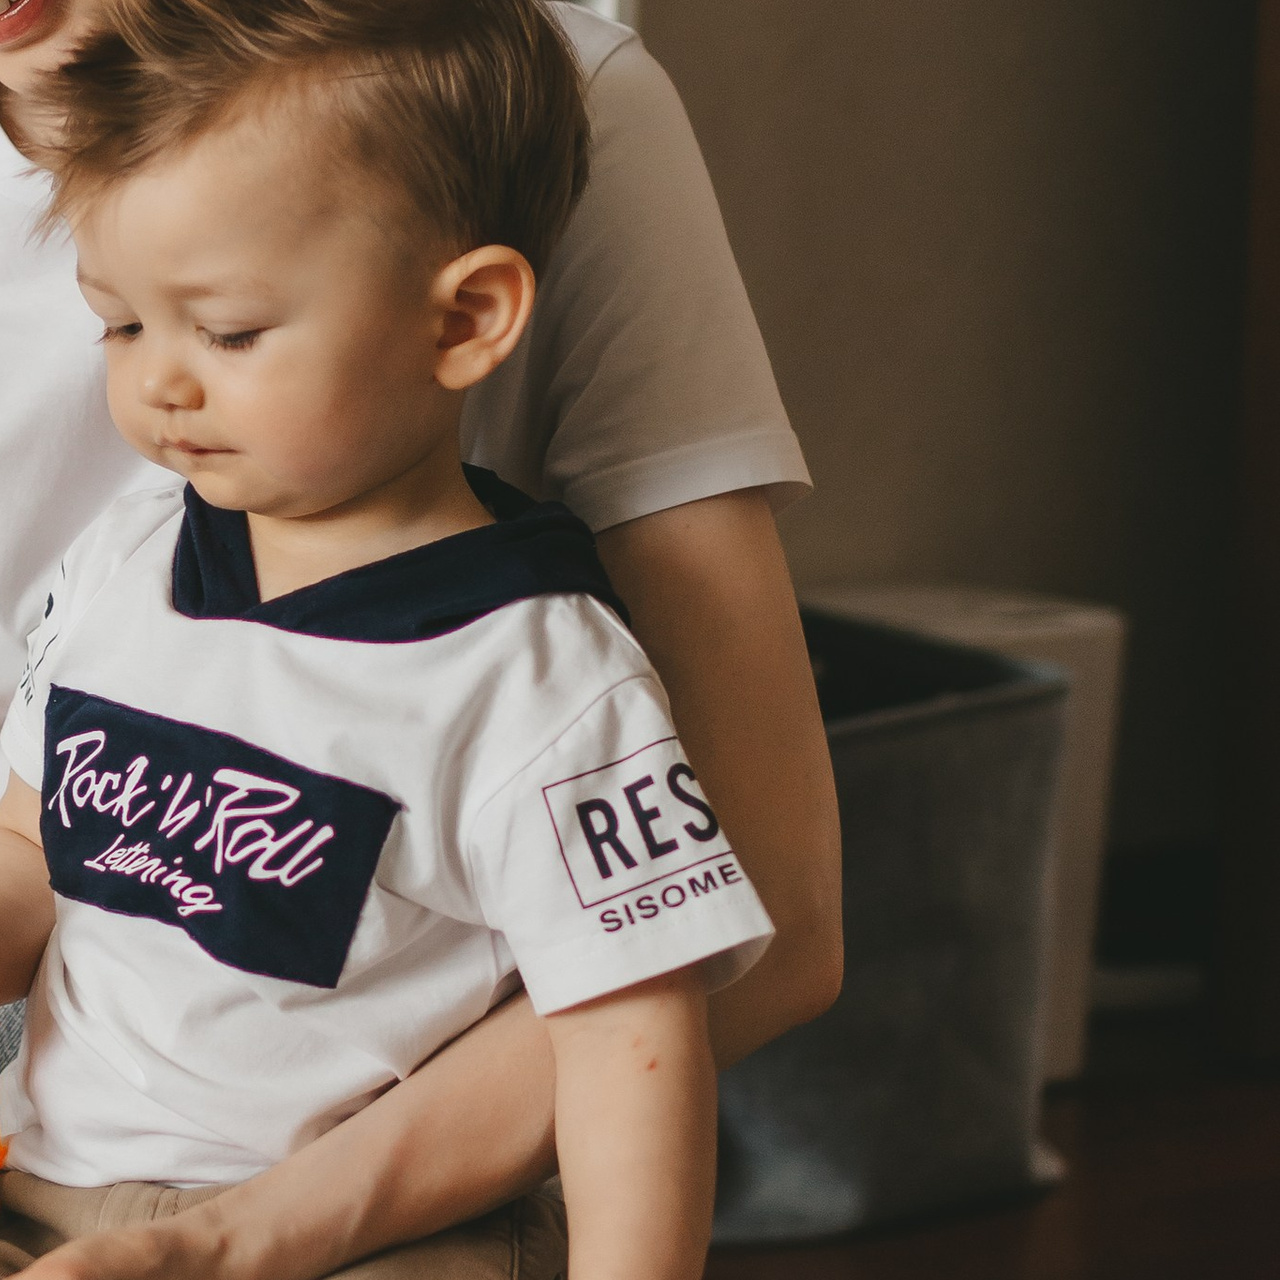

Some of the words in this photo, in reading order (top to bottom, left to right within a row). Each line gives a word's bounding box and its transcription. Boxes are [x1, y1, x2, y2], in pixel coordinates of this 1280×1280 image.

[49, 730, 155, 828] Rock
[195, 768, 334, 887] Roll
[575, 762, 720, 880] RES
[83, 833, 223, 916] Lettering
[599, 862, 742, 933] SISOME
